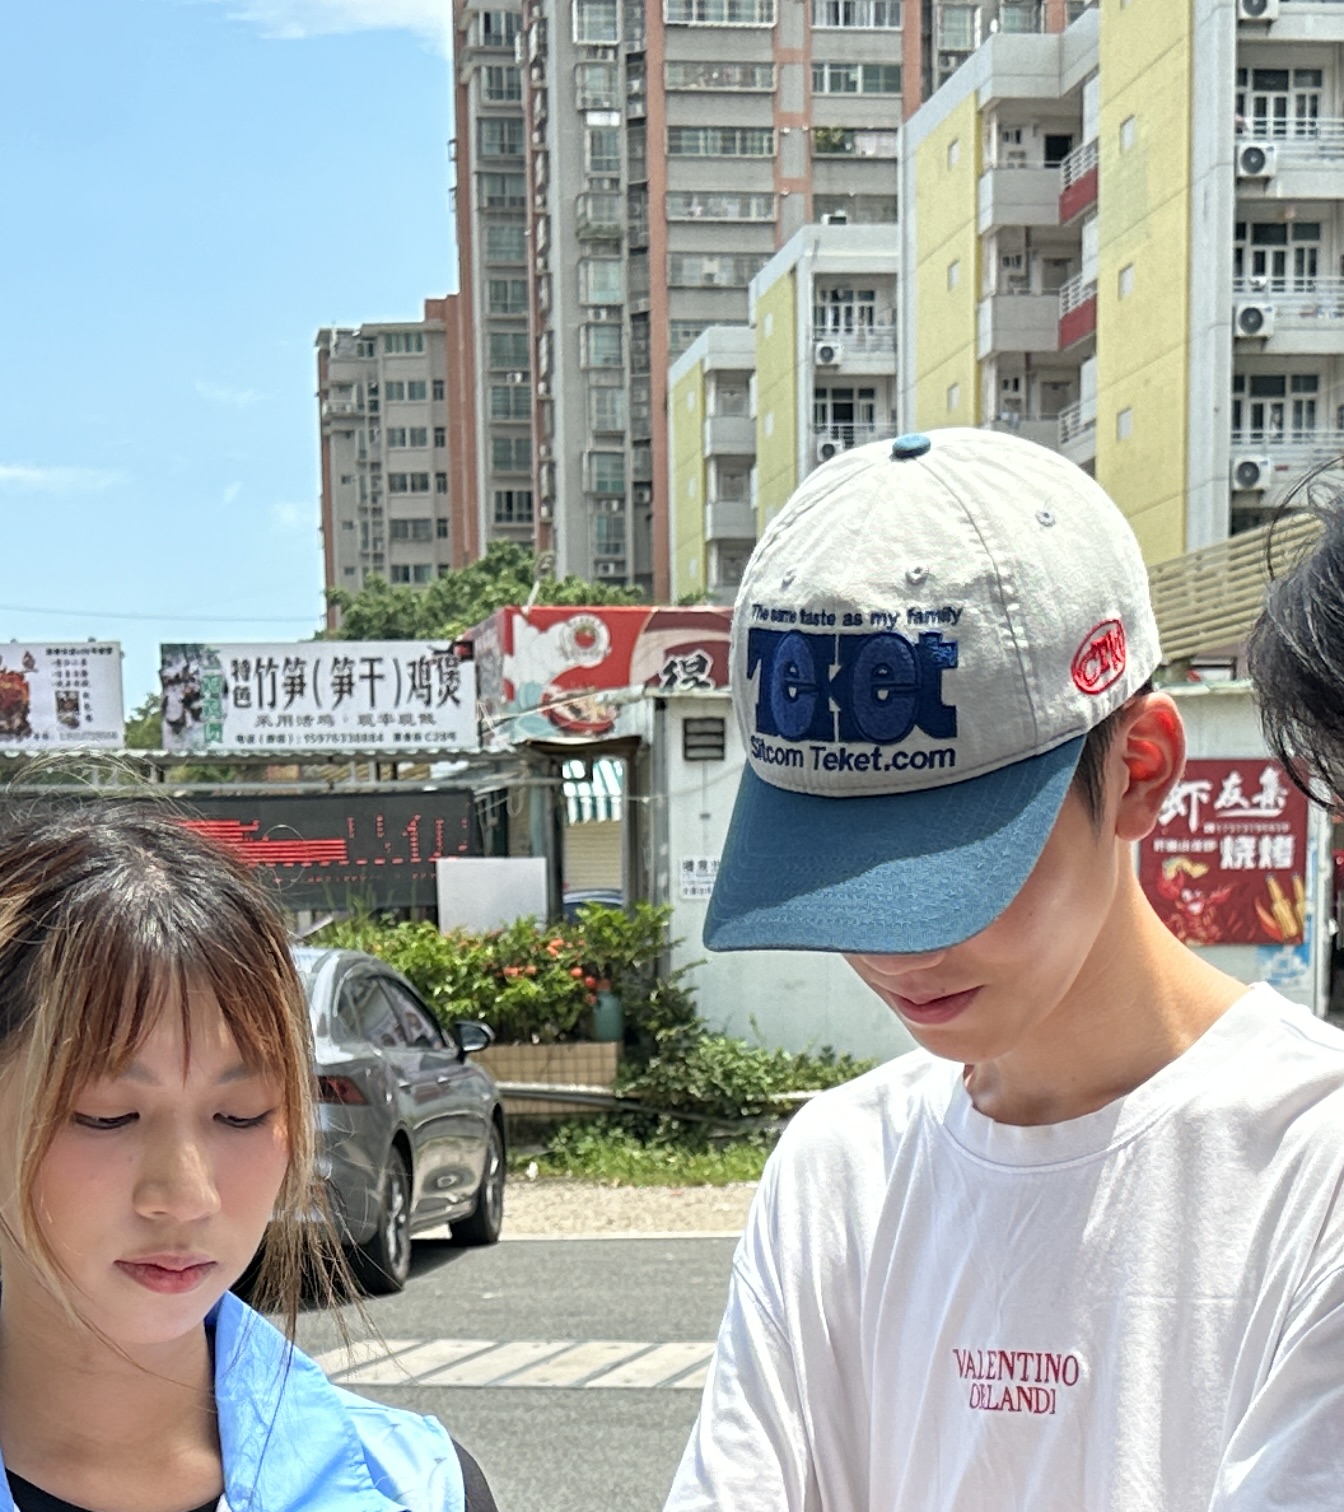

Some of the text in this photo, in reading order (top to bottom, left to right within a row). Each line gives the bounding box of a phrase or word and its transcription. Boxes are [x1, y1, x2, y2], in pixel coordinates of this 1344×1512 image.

[752, 604, 963, 630] The same taste as my family
[751, 735, 956, 771] Sitcom Teket.com
[1219, 834, 1295, 870] 烧烤
[952, 1349, 1080, 1387] VALENTINO
